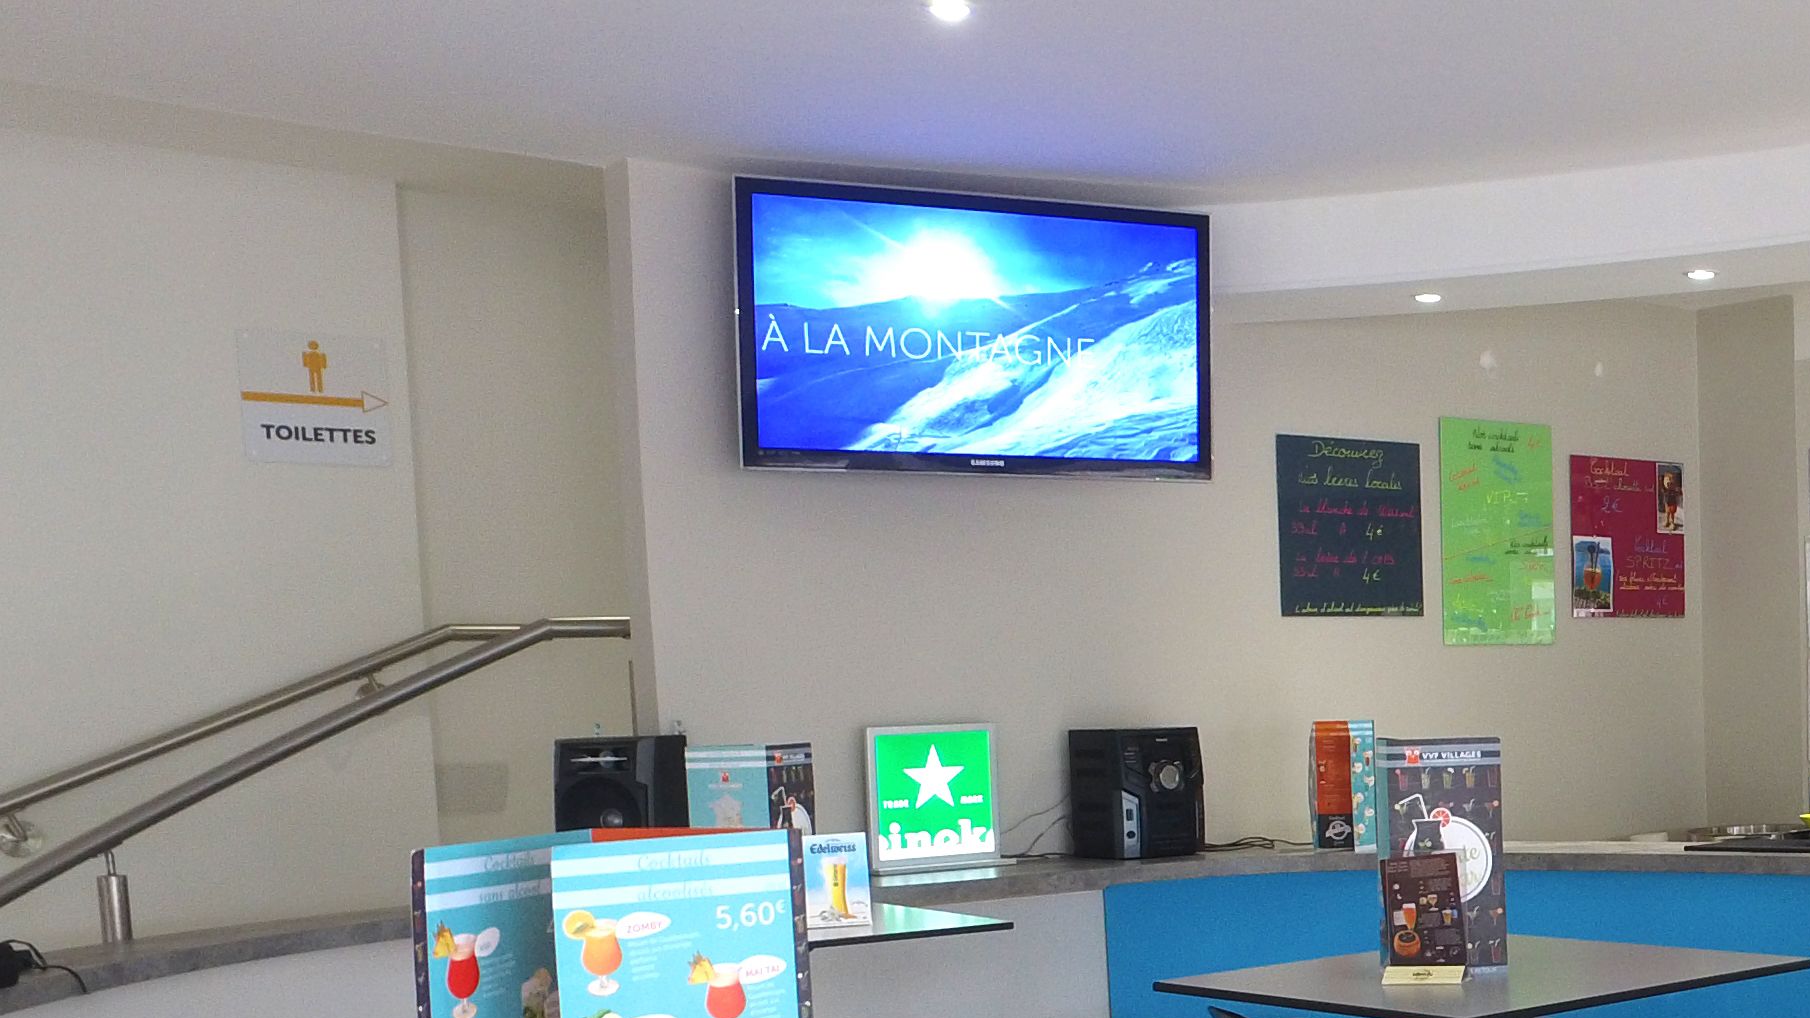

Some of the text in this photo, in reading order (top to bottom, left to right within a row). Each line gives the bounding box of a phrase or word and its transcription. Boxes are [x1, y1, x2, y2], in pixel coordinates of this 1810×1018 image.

[761, 313, 1096, 367] À LA MONTAGNE
[260, 423, 377, 445] TOILETTES
[715, 900, 786, 931] 5,60€
